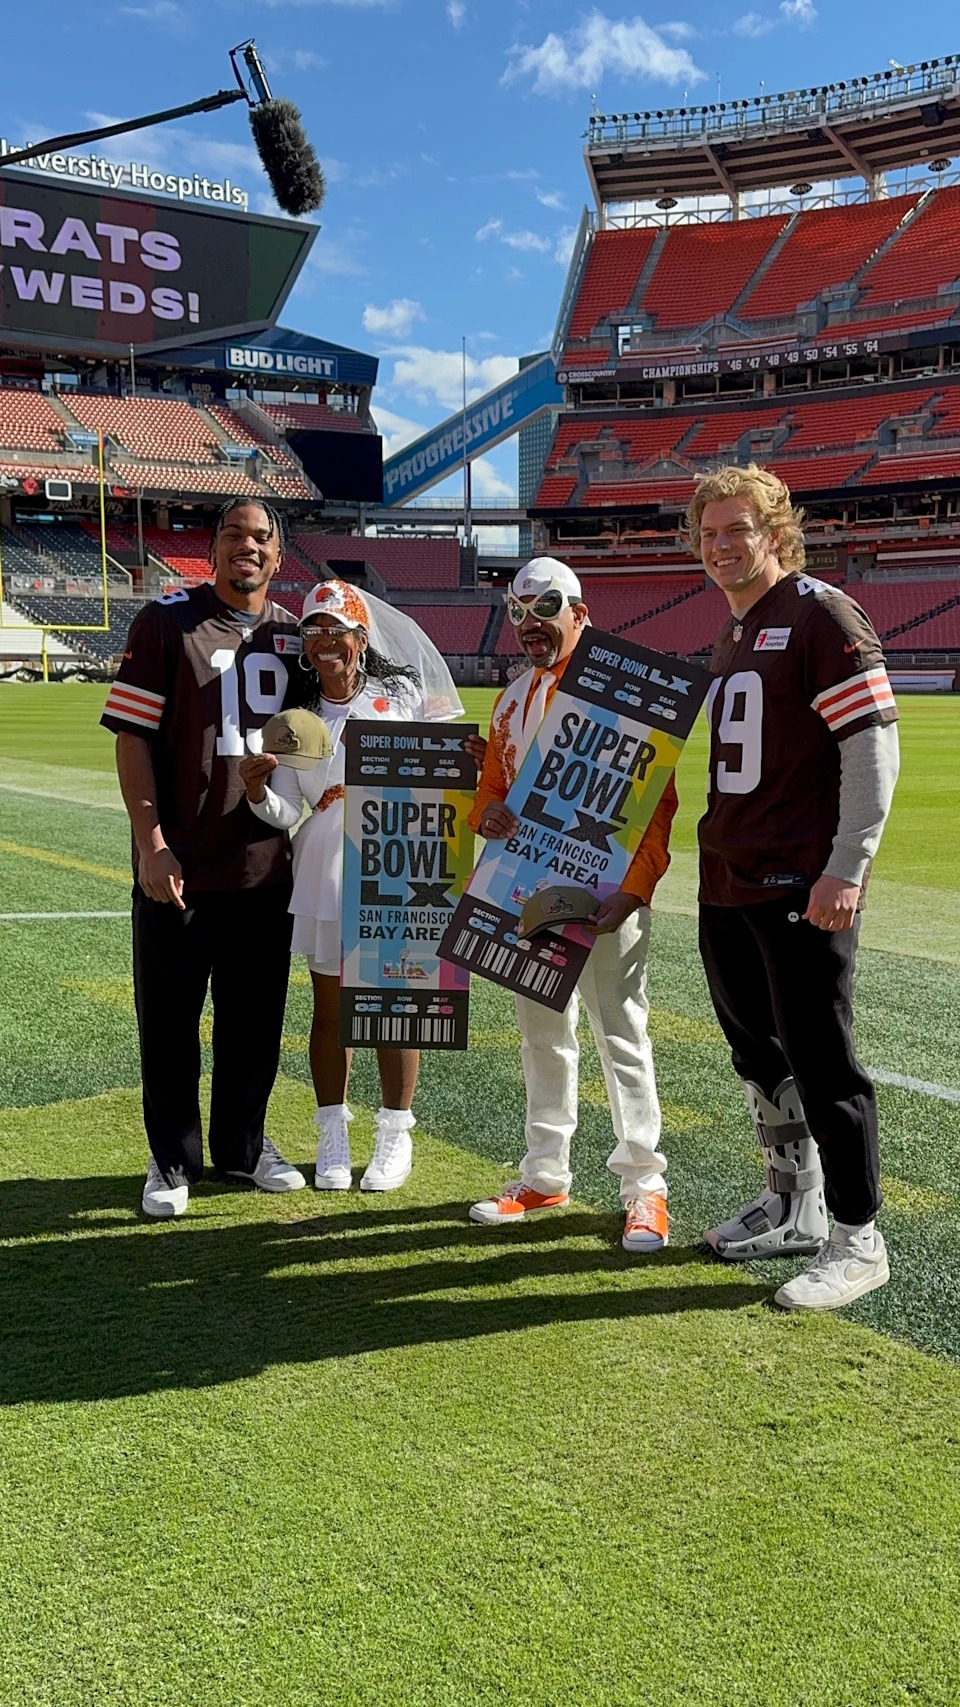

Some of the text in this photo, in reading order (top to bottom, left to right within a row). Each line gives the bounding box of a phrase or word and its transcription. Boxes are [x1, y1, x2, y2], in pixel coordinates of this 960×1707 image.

[131, 162, 243, 205] Hospitals
[0, 265, 200, 324] WEDS!
[230, 347, 334, 376] BUD LIGHT
[568, 370, 616, 378] CROSSCOUNTRY
[642, 340, 879, 379] CHAMPIONSHIPS '46 '47 '48 '49 '50 '54 '55 '64
[385, 391, 514, 495] PROGRESSIVE
[816, 556, 838, 564] FIELD
[583, 667, 677, 707] SECTION ROW SEAT
[589, 645, 693, 696] SUPER BOWL LX
[210, 649, 289, 756] 19
[577, 675, 678, 721] 02 08 26
[360, 735, 463, 752] SUPER BOWL LX
[554, 712, 656, 782] SUPER
[360, 765, 461, 778] 02 08 26
[533, 749, 633, 825] BOWL
[361, 800, 457, 838] SUPER
[519, 791, 623, 855] LX
[361, 838, 456, 879] BOWL
[504, 838, 599, 890] BAY AREA
[518, 822, 609, 872] AN FRANCISCO
[360, 880, 456, 908] LX
[359, 909, 382, 923] SAN
[359, 925, 447, 941] BAY ARE
[473, 907, 501, 923] SECTION
[468, 916, 497, 936] 02
[503, 932, 533, 951] 08
[537, 948, 568, 968] 26
[549, 941, 567, 953] SEAT
[354, 1003, 454, 1015] 02 08 26
